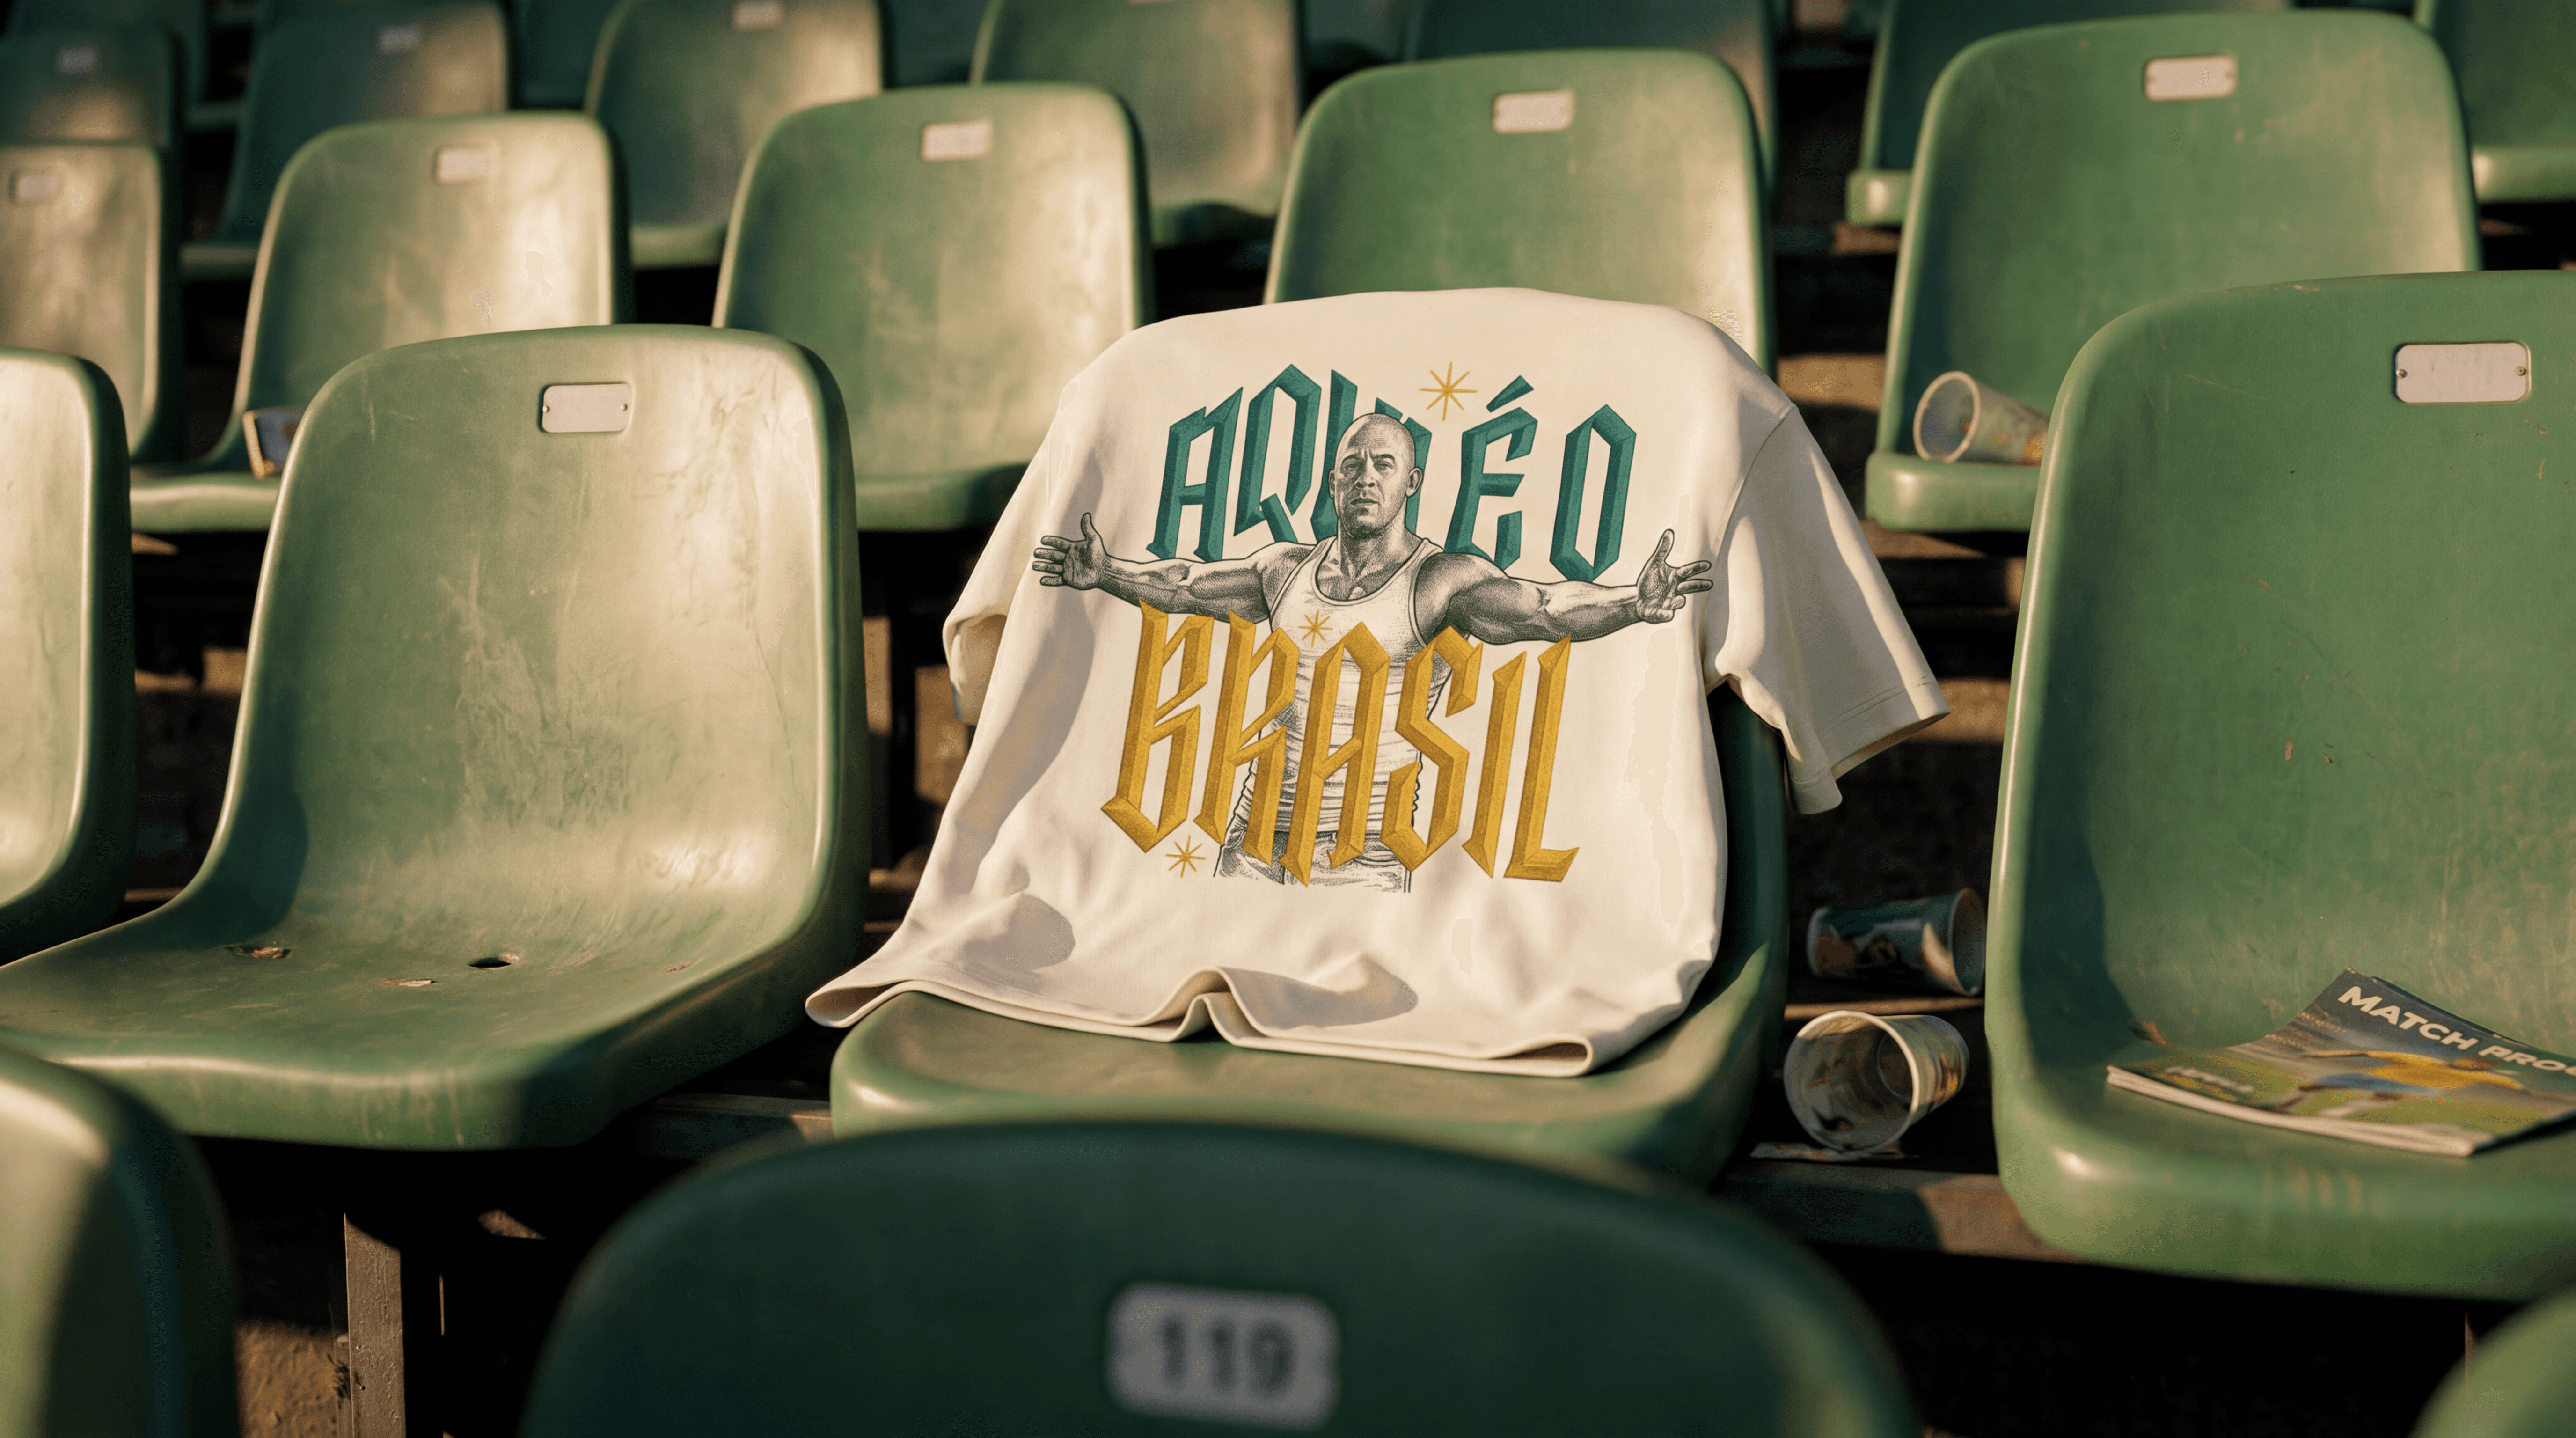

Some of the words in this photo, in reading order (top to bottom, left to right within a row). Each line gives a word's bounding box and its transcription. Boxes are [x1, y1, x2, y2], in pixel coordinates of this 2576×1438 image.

[1445, 375, 1538, 570] É
[1549, 404, 1637, 584] O
[1100, 599, 1580, 887] BRASIL
[2337, 985, 2479, 1050] MATCH
[1157, 1316, 1297, 1399] 119
